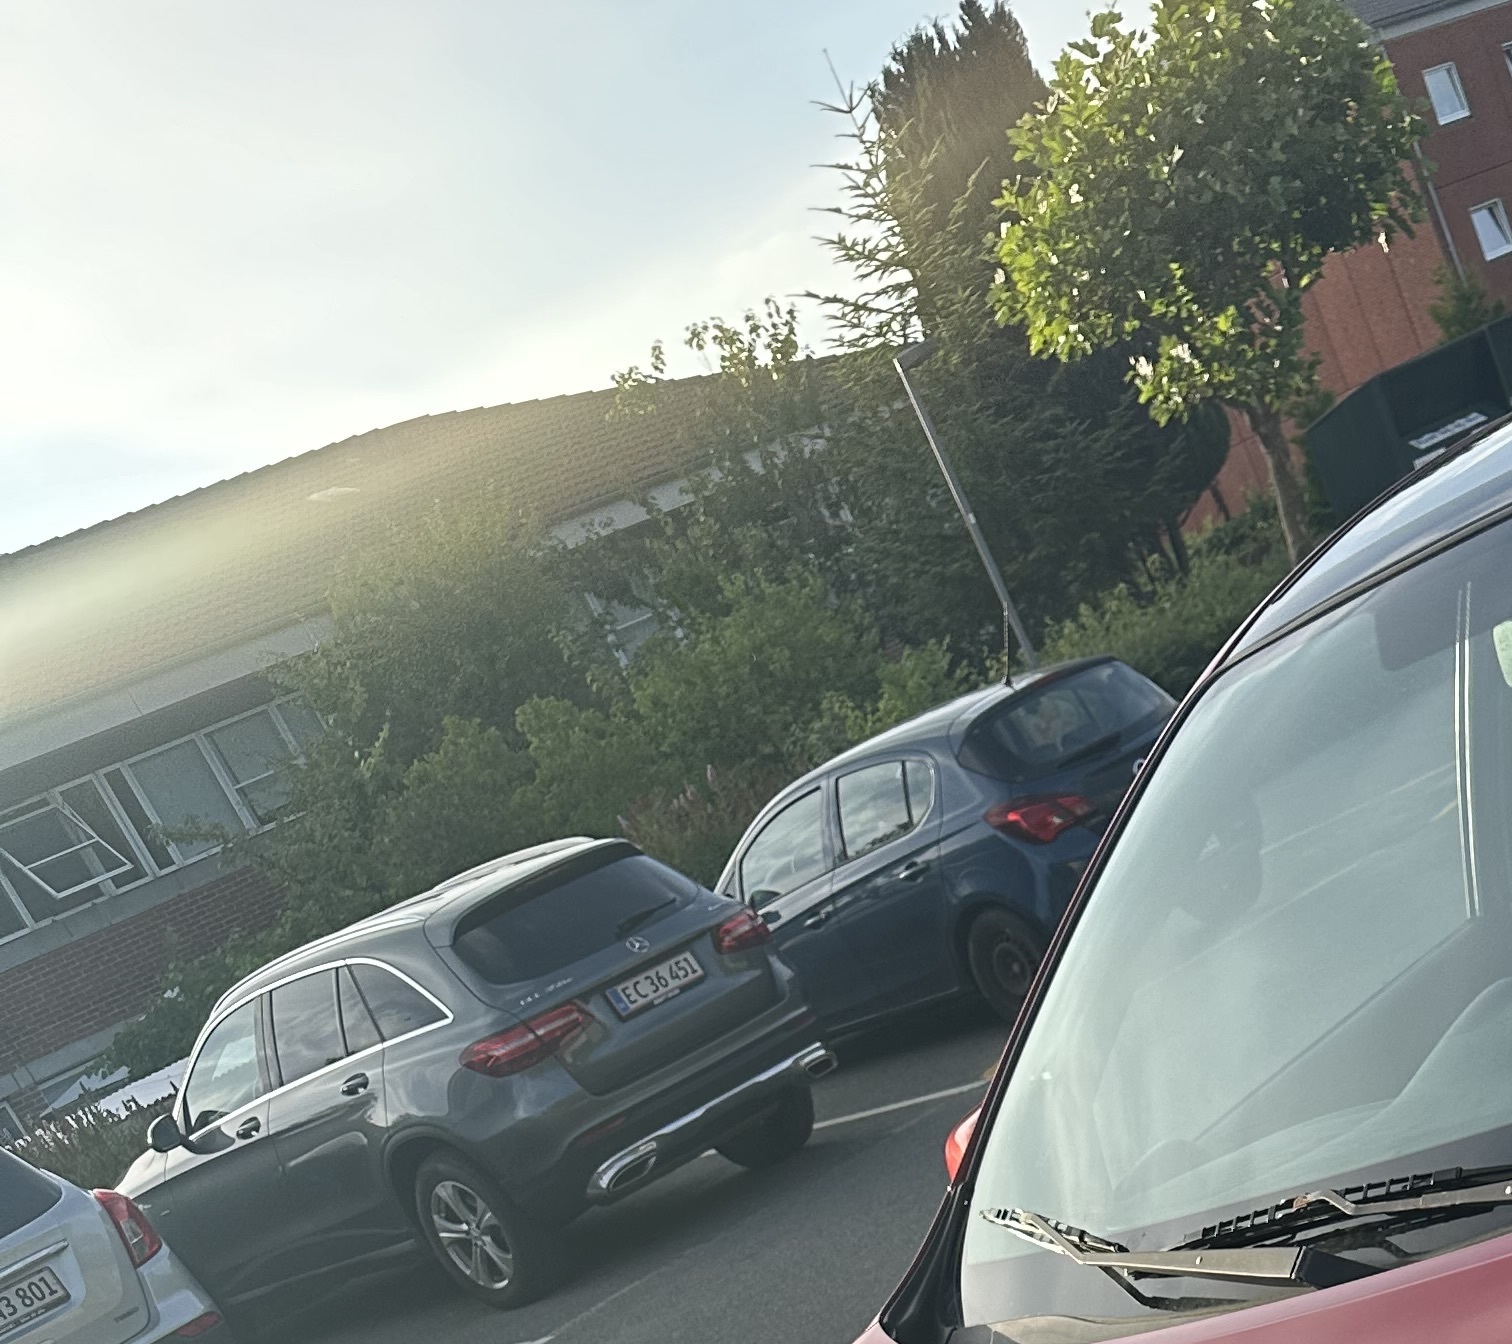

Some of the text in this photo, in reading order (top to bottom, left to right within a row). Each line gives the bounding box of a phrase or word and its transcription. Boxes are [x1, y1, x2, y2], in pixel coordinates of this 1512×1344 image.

[621, 981, 649, 1005] EC
[644, 970, 669, 994] 36
[669, 957, 698, 981] 451
[15, 1276, 58, 1308] 801
